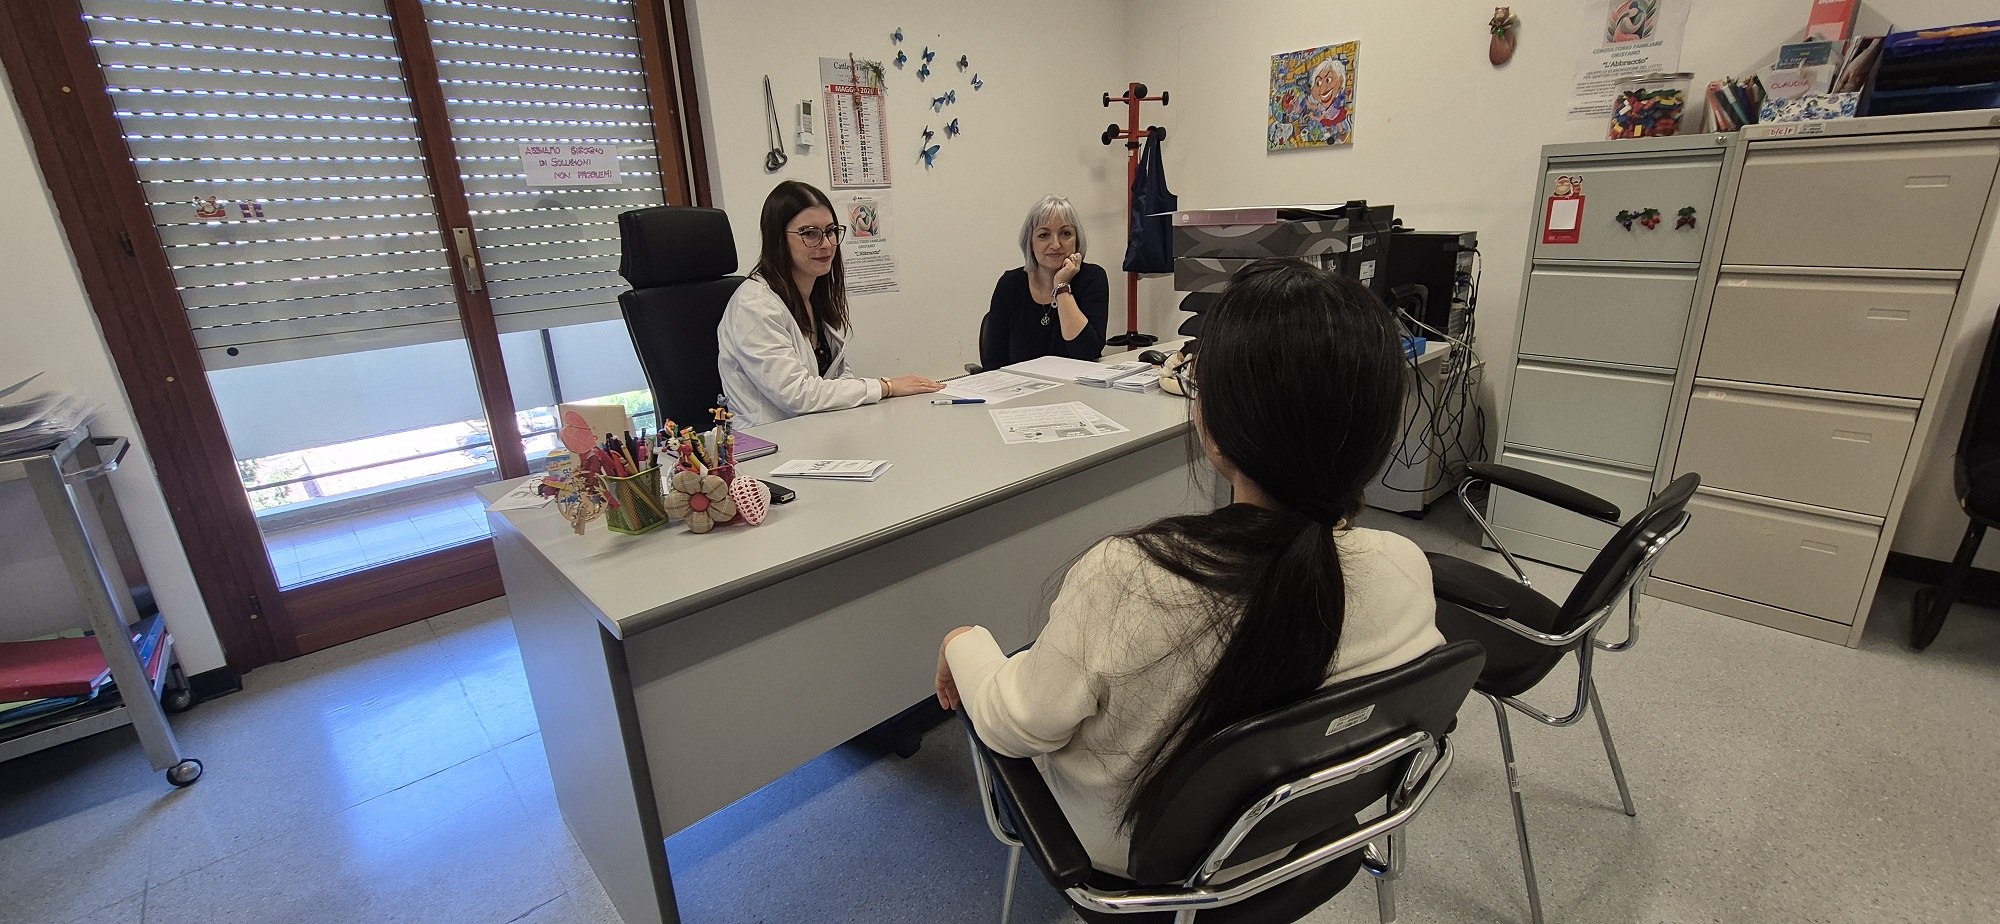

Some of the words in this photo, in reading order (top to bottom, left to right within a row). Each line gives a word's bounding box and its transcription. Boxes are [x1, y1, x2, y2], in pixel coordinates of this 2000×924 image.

[1593, 45, 1632, 54] CONSULTORIO
[1633, 40, 1663, 49] FAMILIARE
[1611, 50, 1640, 58] ORISTANO
[833, 61, 855, 72] Cattley
[1771, 81, 1808, 89] CLAUDIA
[525, 146, 561, 155] ABBIAMO
[570, 146, 604, 155] BISOGNO
[554, 171, 570, 179] NON
[578, 169, 612, 179] PROBLEMI
